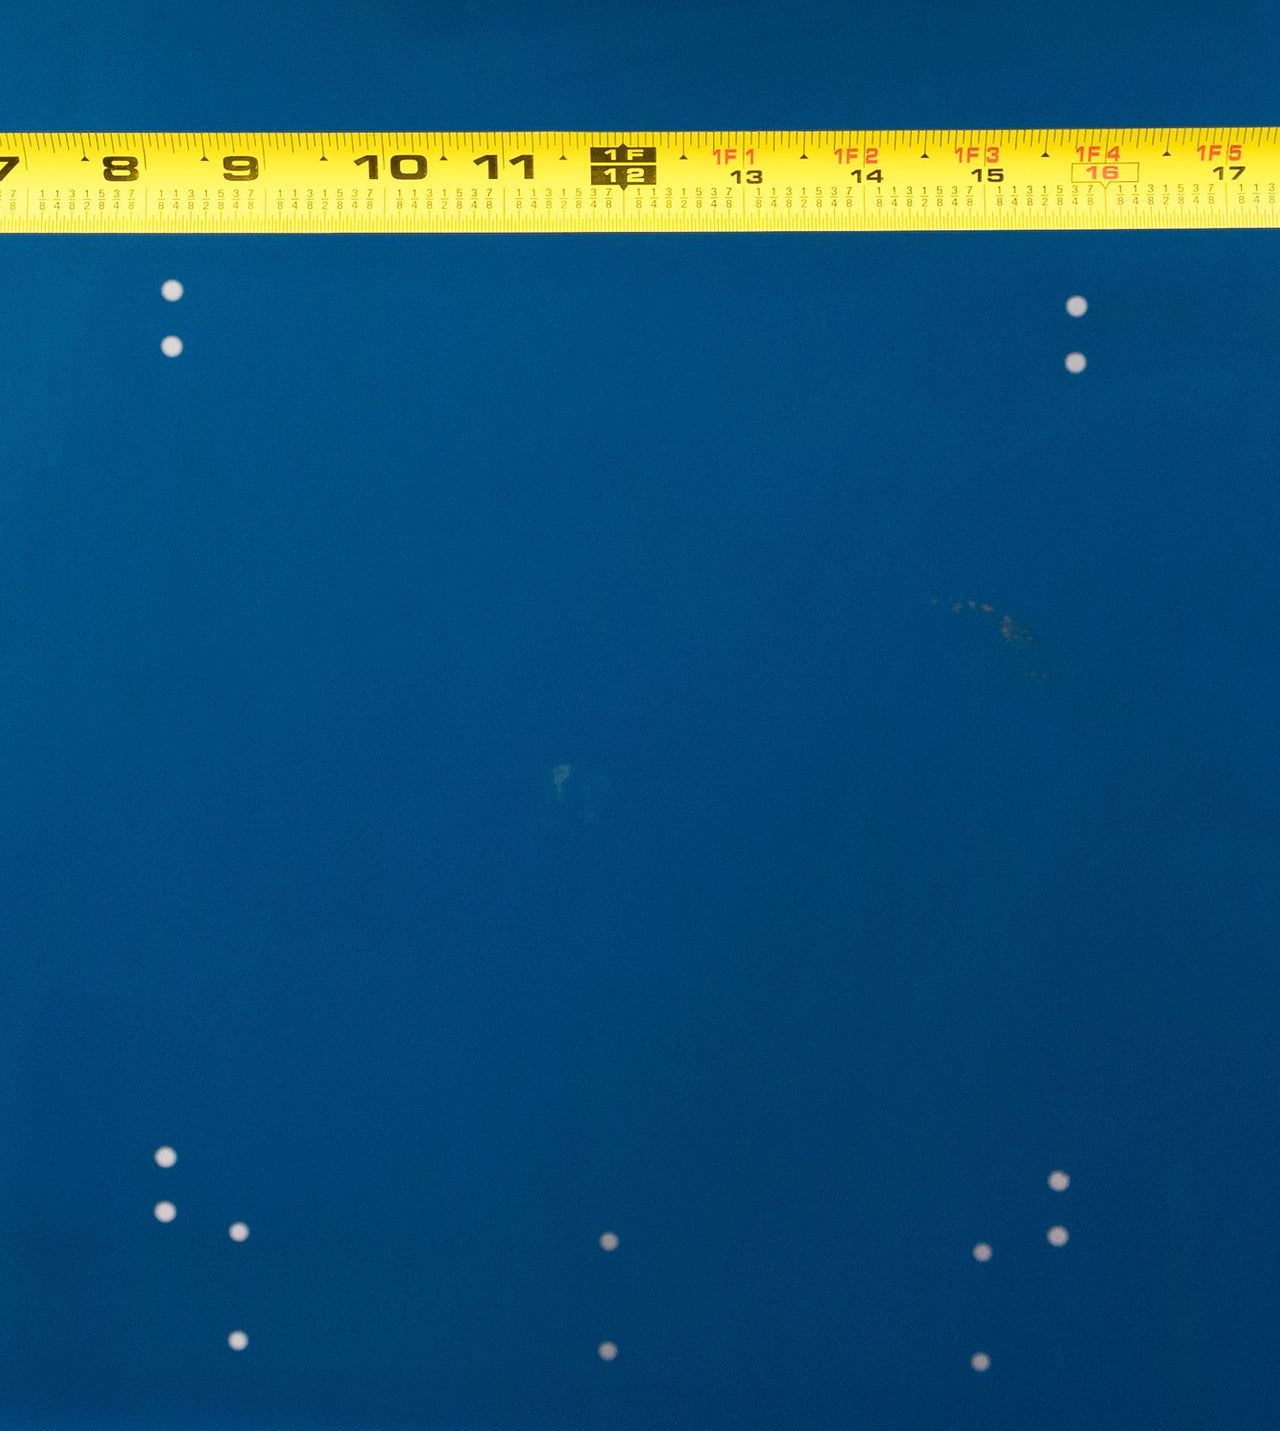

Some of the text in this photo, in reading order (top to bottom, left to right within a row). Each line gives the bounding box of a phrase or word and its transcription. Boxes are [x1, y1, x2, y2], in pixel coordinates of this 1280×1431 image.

[102, 156, 139, 182] 8
[222, 155, 259, 181] 9
[353, 155, 428, 180] 10
[473, 154, 534, 180] 11
[1086, 166, 1119, 180] 16
[1213, 166, 1246, 180] 17
[603, 168, 645, 182] 12
[730, 170, 763, 184] 13
[850, 169, 883, 183] 14
[971, 168, 1004, 182] 15
